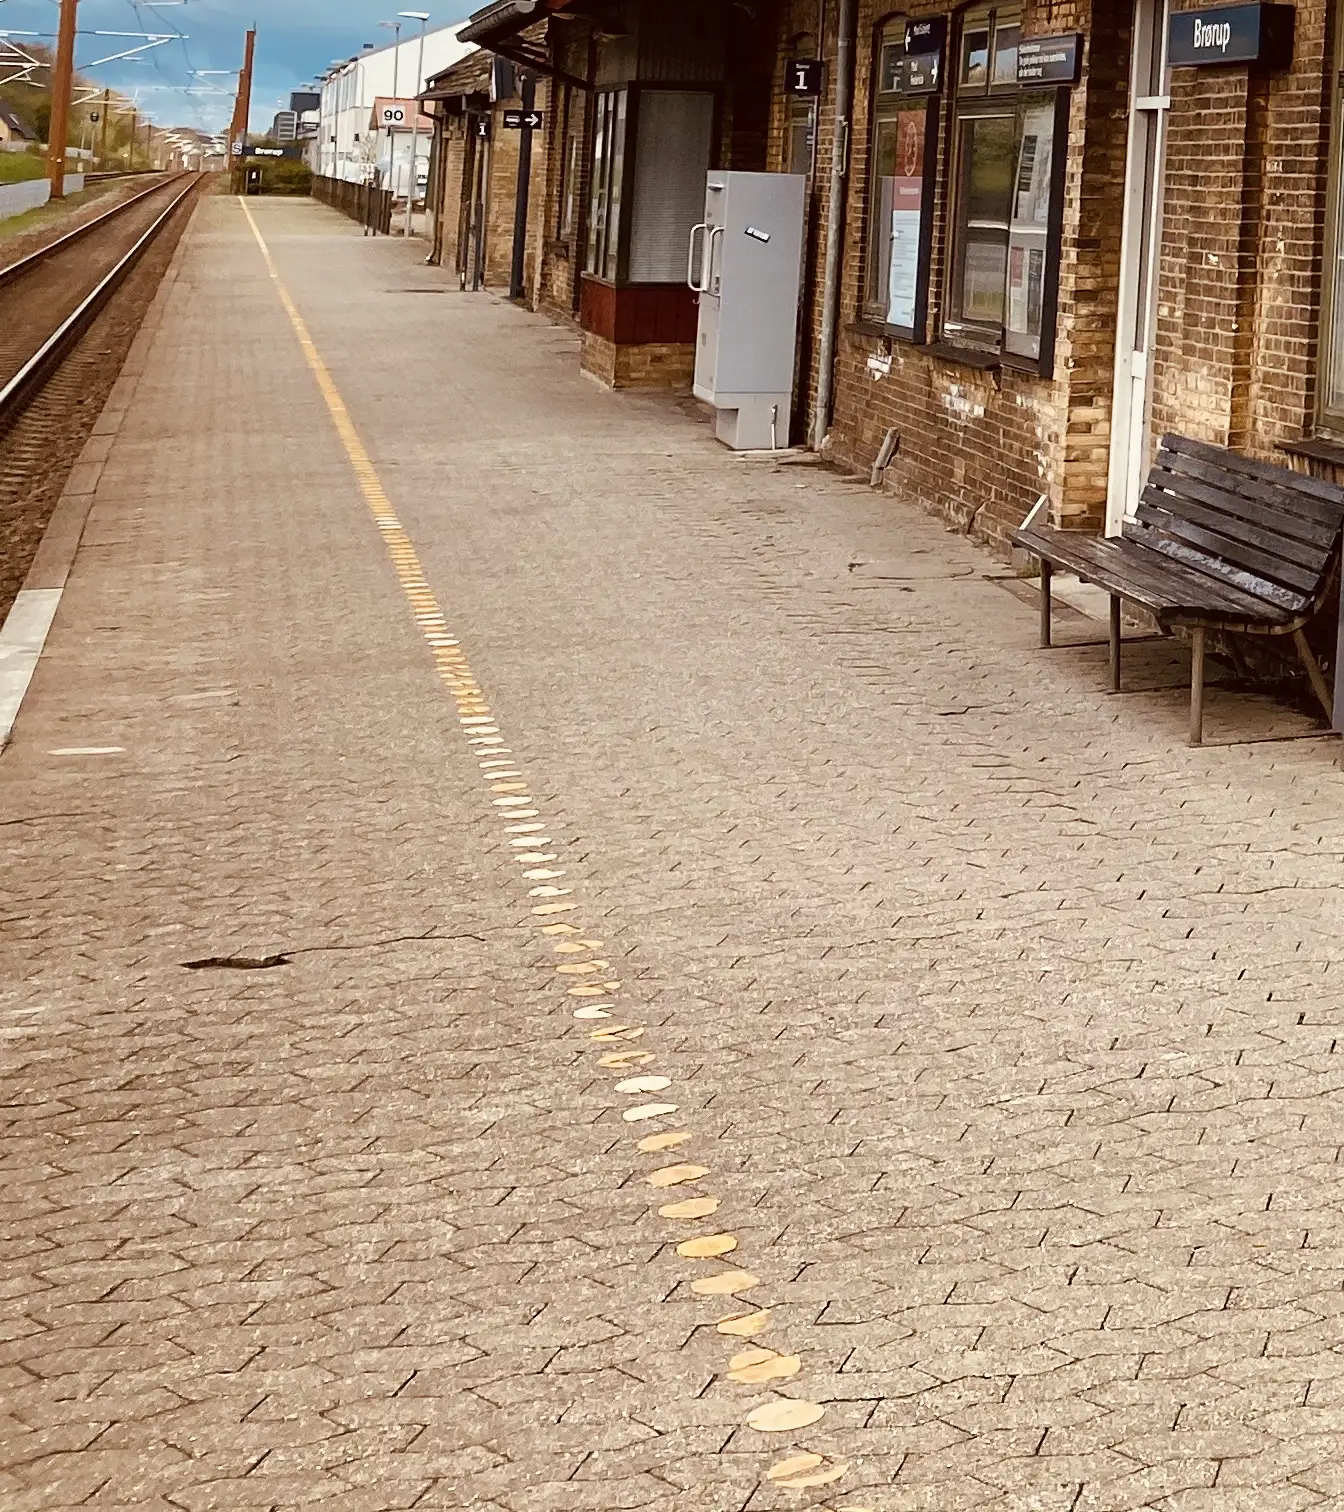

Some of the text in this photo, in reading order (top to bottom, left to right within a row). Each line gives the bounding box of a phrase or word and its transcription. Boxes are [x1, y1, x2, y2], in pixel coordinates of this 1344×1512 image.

[1193, 18, 1231, 53] Brørup
[794, 71, 808, 90] 1
[384, 110, 403, 121] 90
